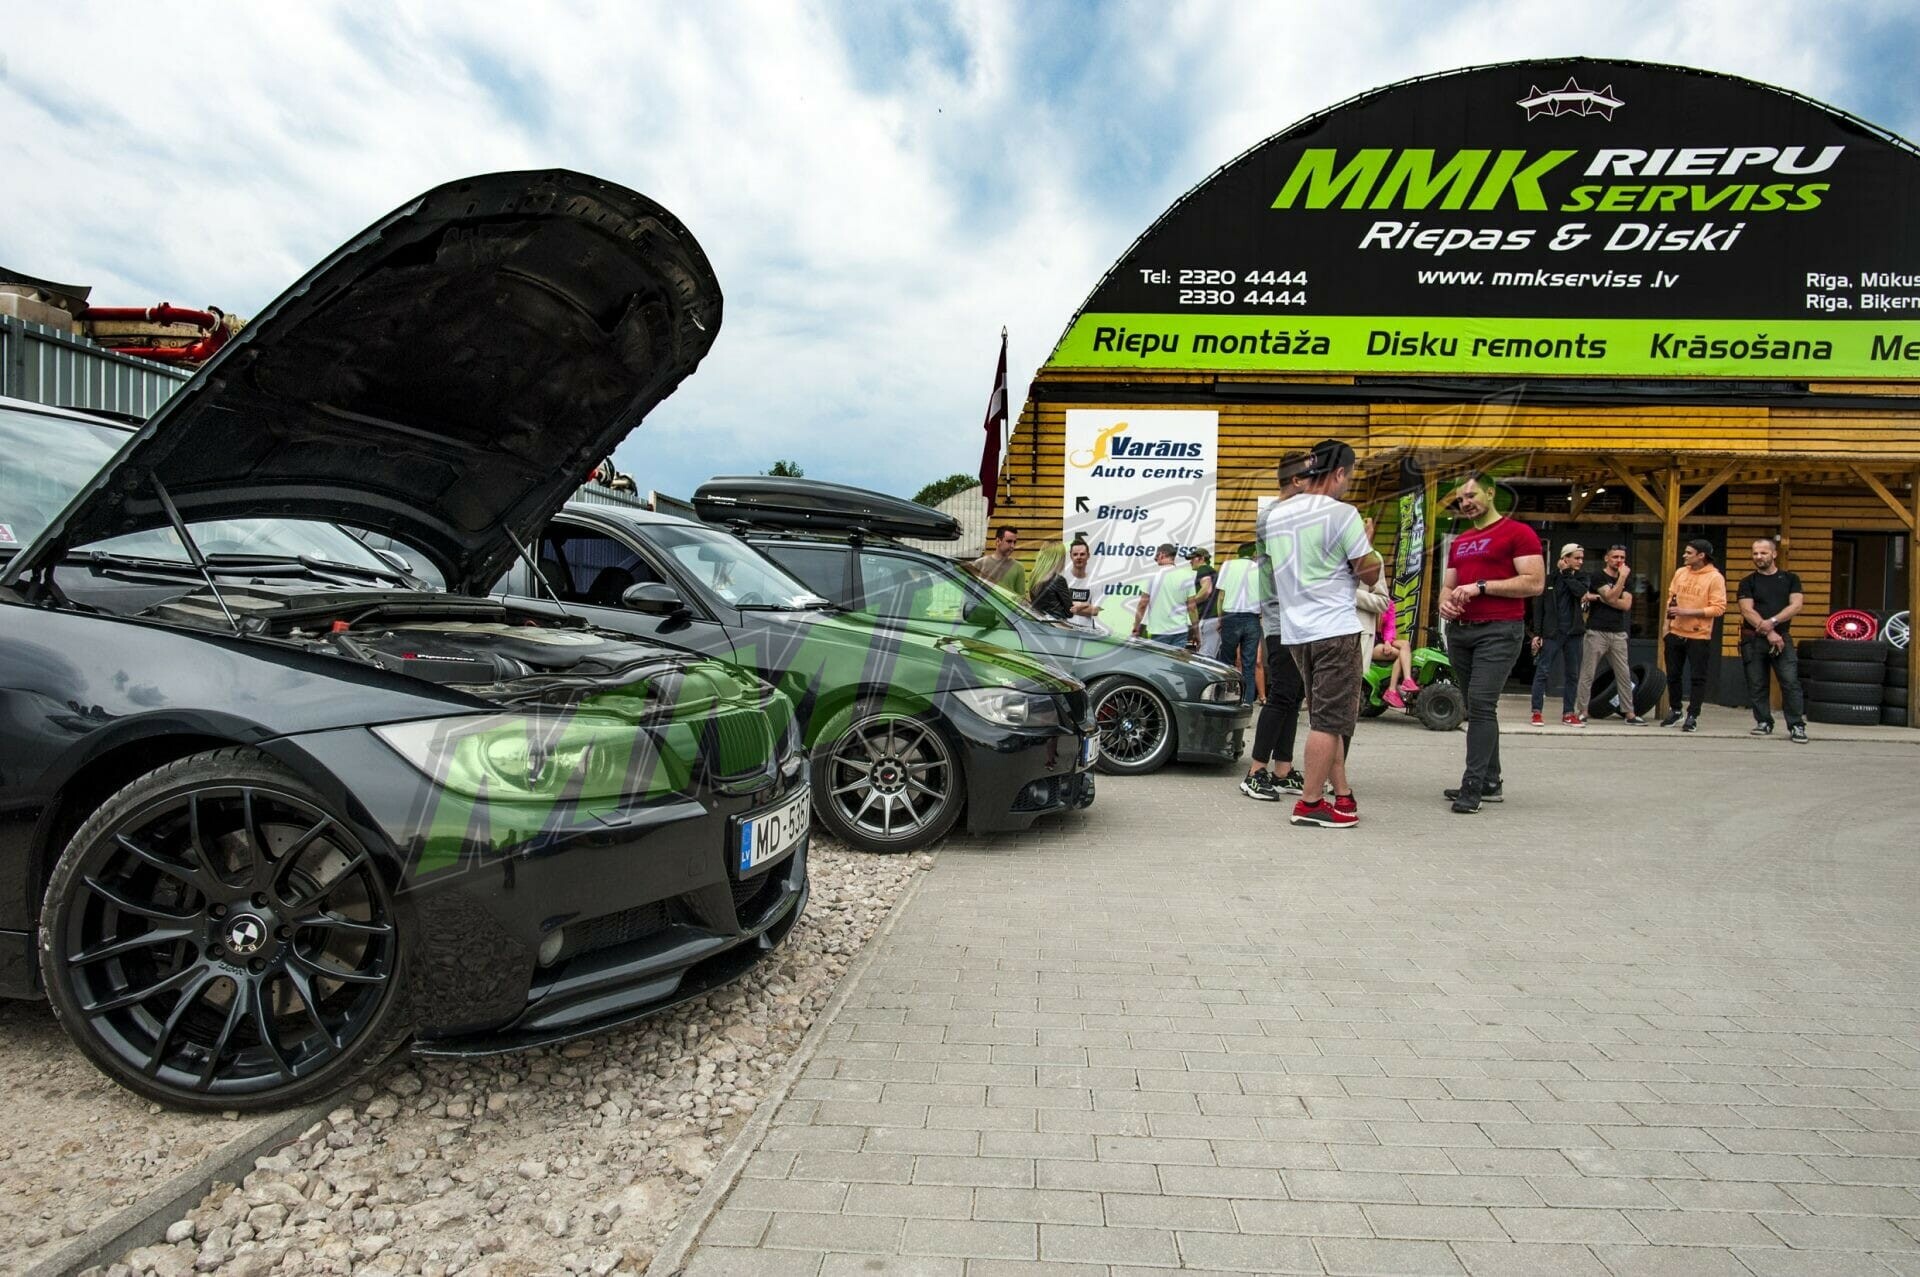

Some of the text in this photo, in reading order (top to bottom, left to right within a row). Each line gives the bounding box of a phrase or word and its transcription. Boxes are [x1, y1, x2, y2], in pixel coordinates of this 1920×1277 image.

[1583, 145, 1845, 176] RIEPU
[1271, 148, 1578, 211] MMK
[1560, 183, 1830, 212] SERVISS
[1358, 221, 1746, 256] Riepas & Diski
[1140, 269, 1308, 286] Tel: 2320 4444
[1806, 272, 1853, 291] Rīga,
[1179, 289, 1307, 306] 2330 4444
[1806, 294, 1853, 312] Rīga,
[1093, 327, 1331, 358] Riepu montāža
[1367, 331, 1608, 359] Disku remonts
[1650, 333, 1833, 361] Krāsošana
[1871, 335, 1920, 361] Me
[1111, 436, 1203, 457] Varāns
[1091, 465, 1204, 479] Auto centrs
[1097, 505, 1149, 523] Birojs
[1094, 542, 1198, 558] Autoseiss
[1456, 538, 1492, 555] EA7
[741, 849, 751, 862] LV
